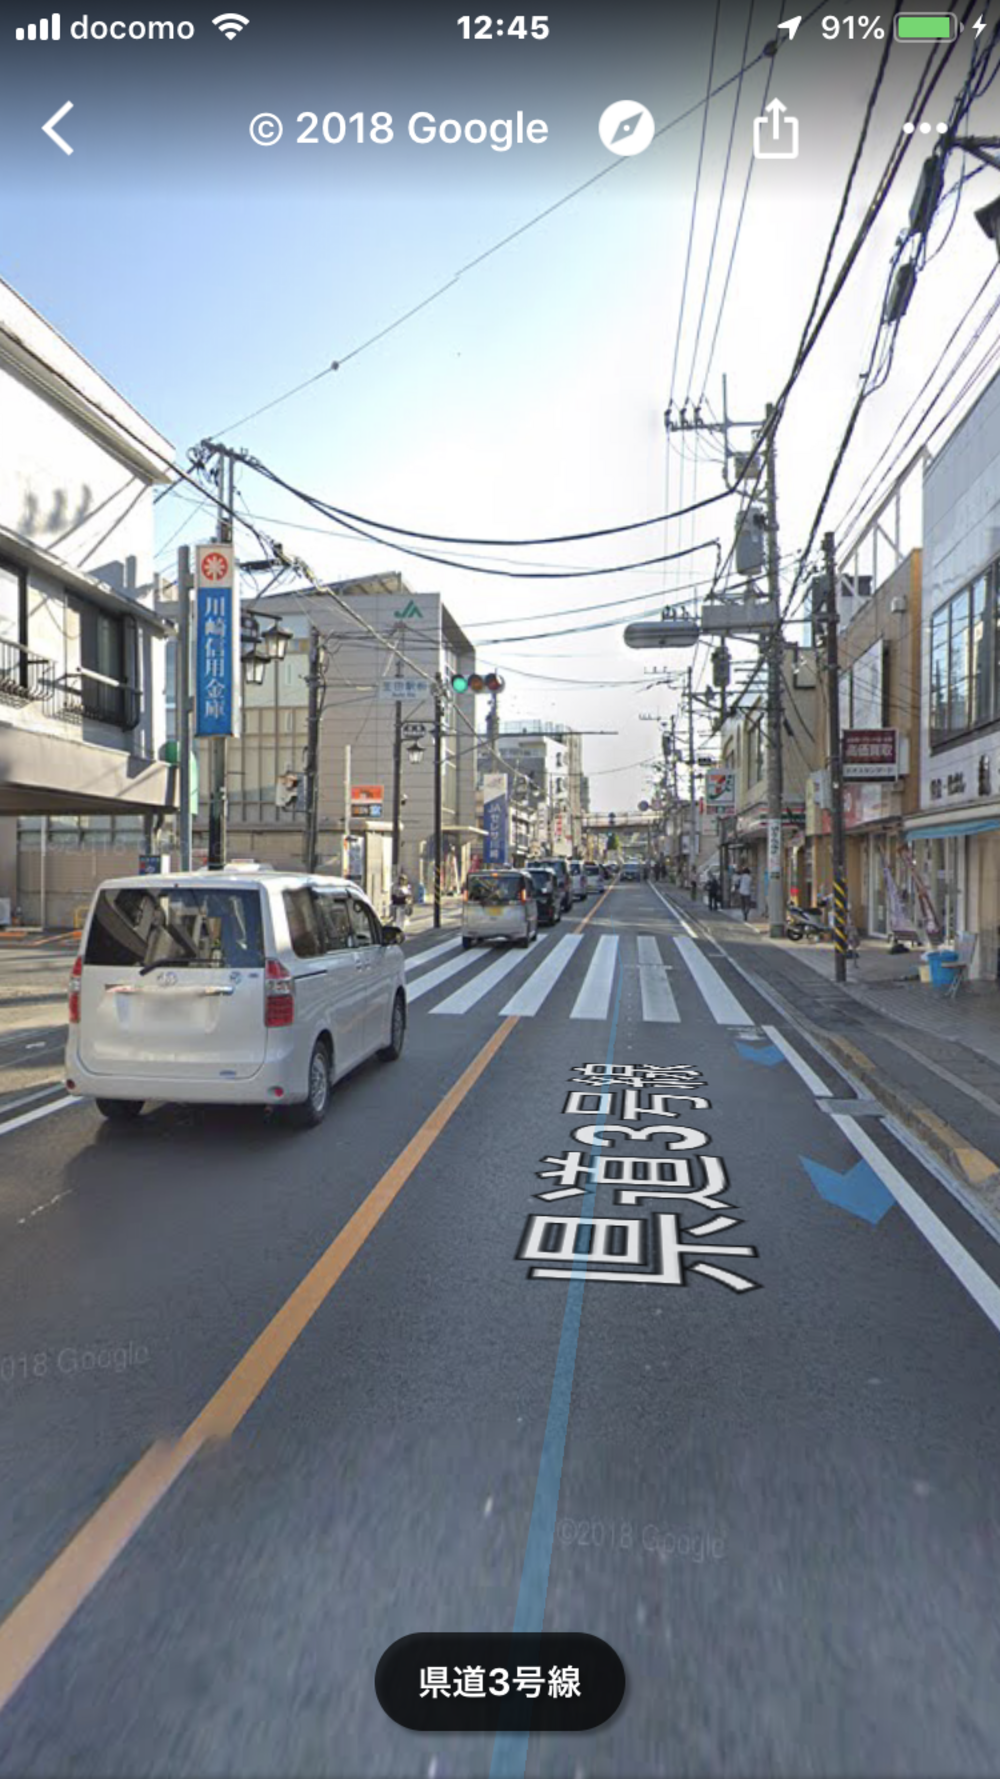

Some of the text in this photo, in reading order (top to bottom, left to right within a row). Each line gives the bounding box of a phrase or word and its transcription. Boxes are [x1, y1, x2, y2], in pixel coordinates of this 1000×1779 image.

[204, 596, 226, 719] 川崎信用金庫
